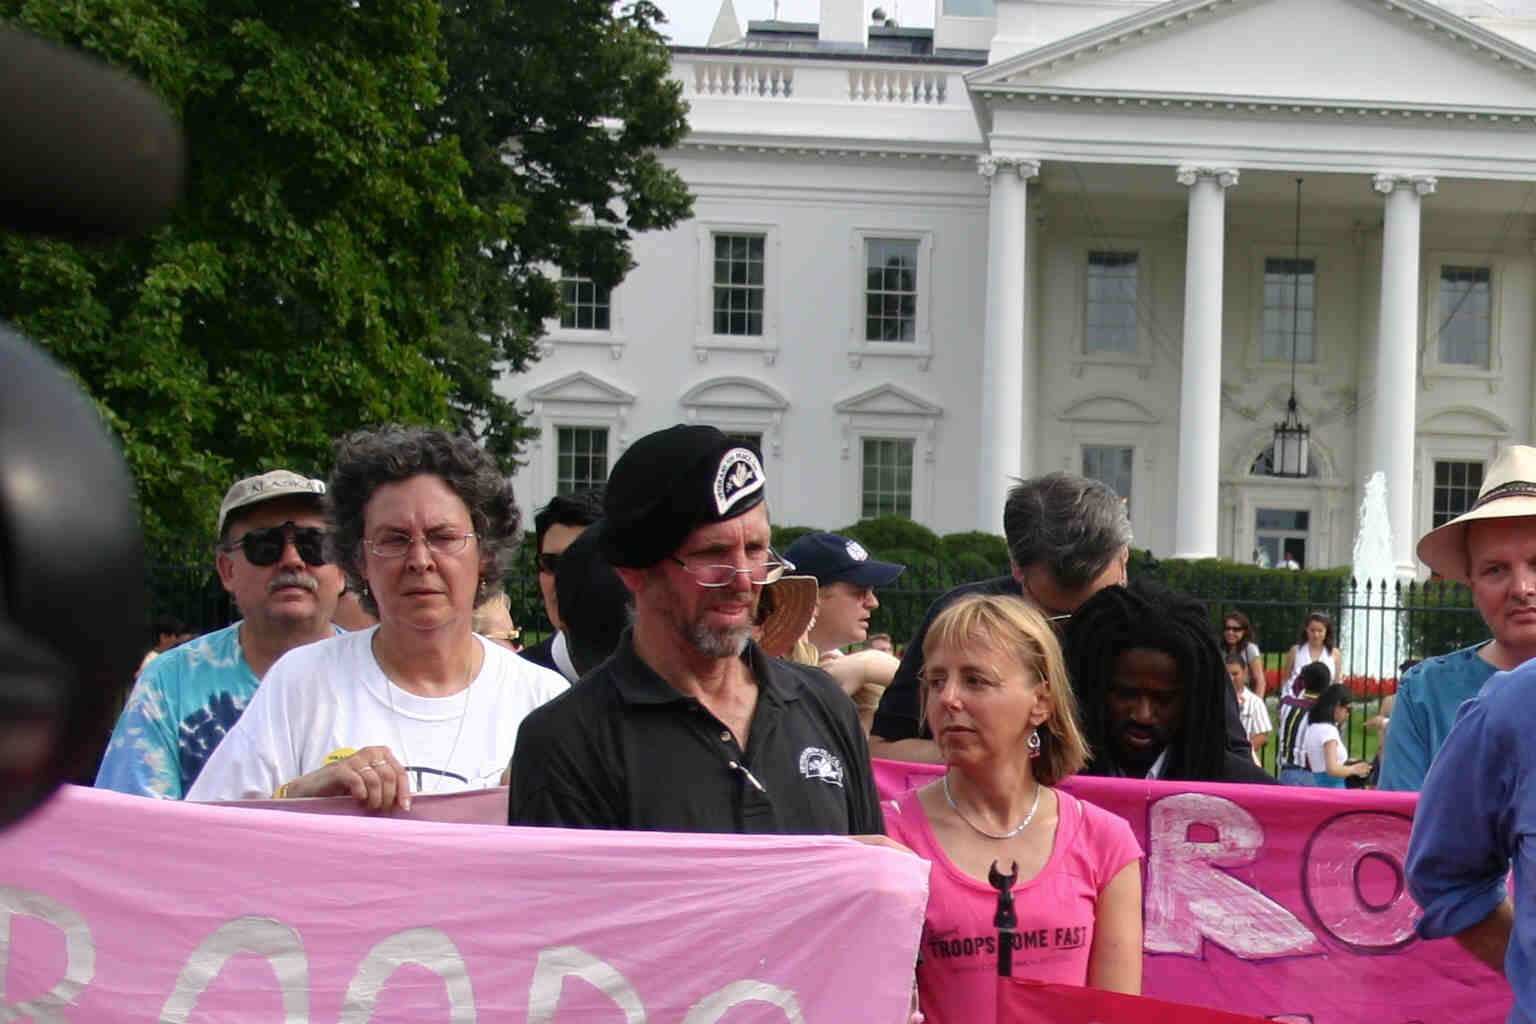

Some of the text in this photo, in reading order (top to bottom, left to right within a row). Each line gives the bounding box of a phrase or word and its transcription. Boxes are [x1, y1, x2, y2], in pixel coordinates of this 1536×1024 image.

[929, 926, 1088, 959] TROOPS OME FAST
